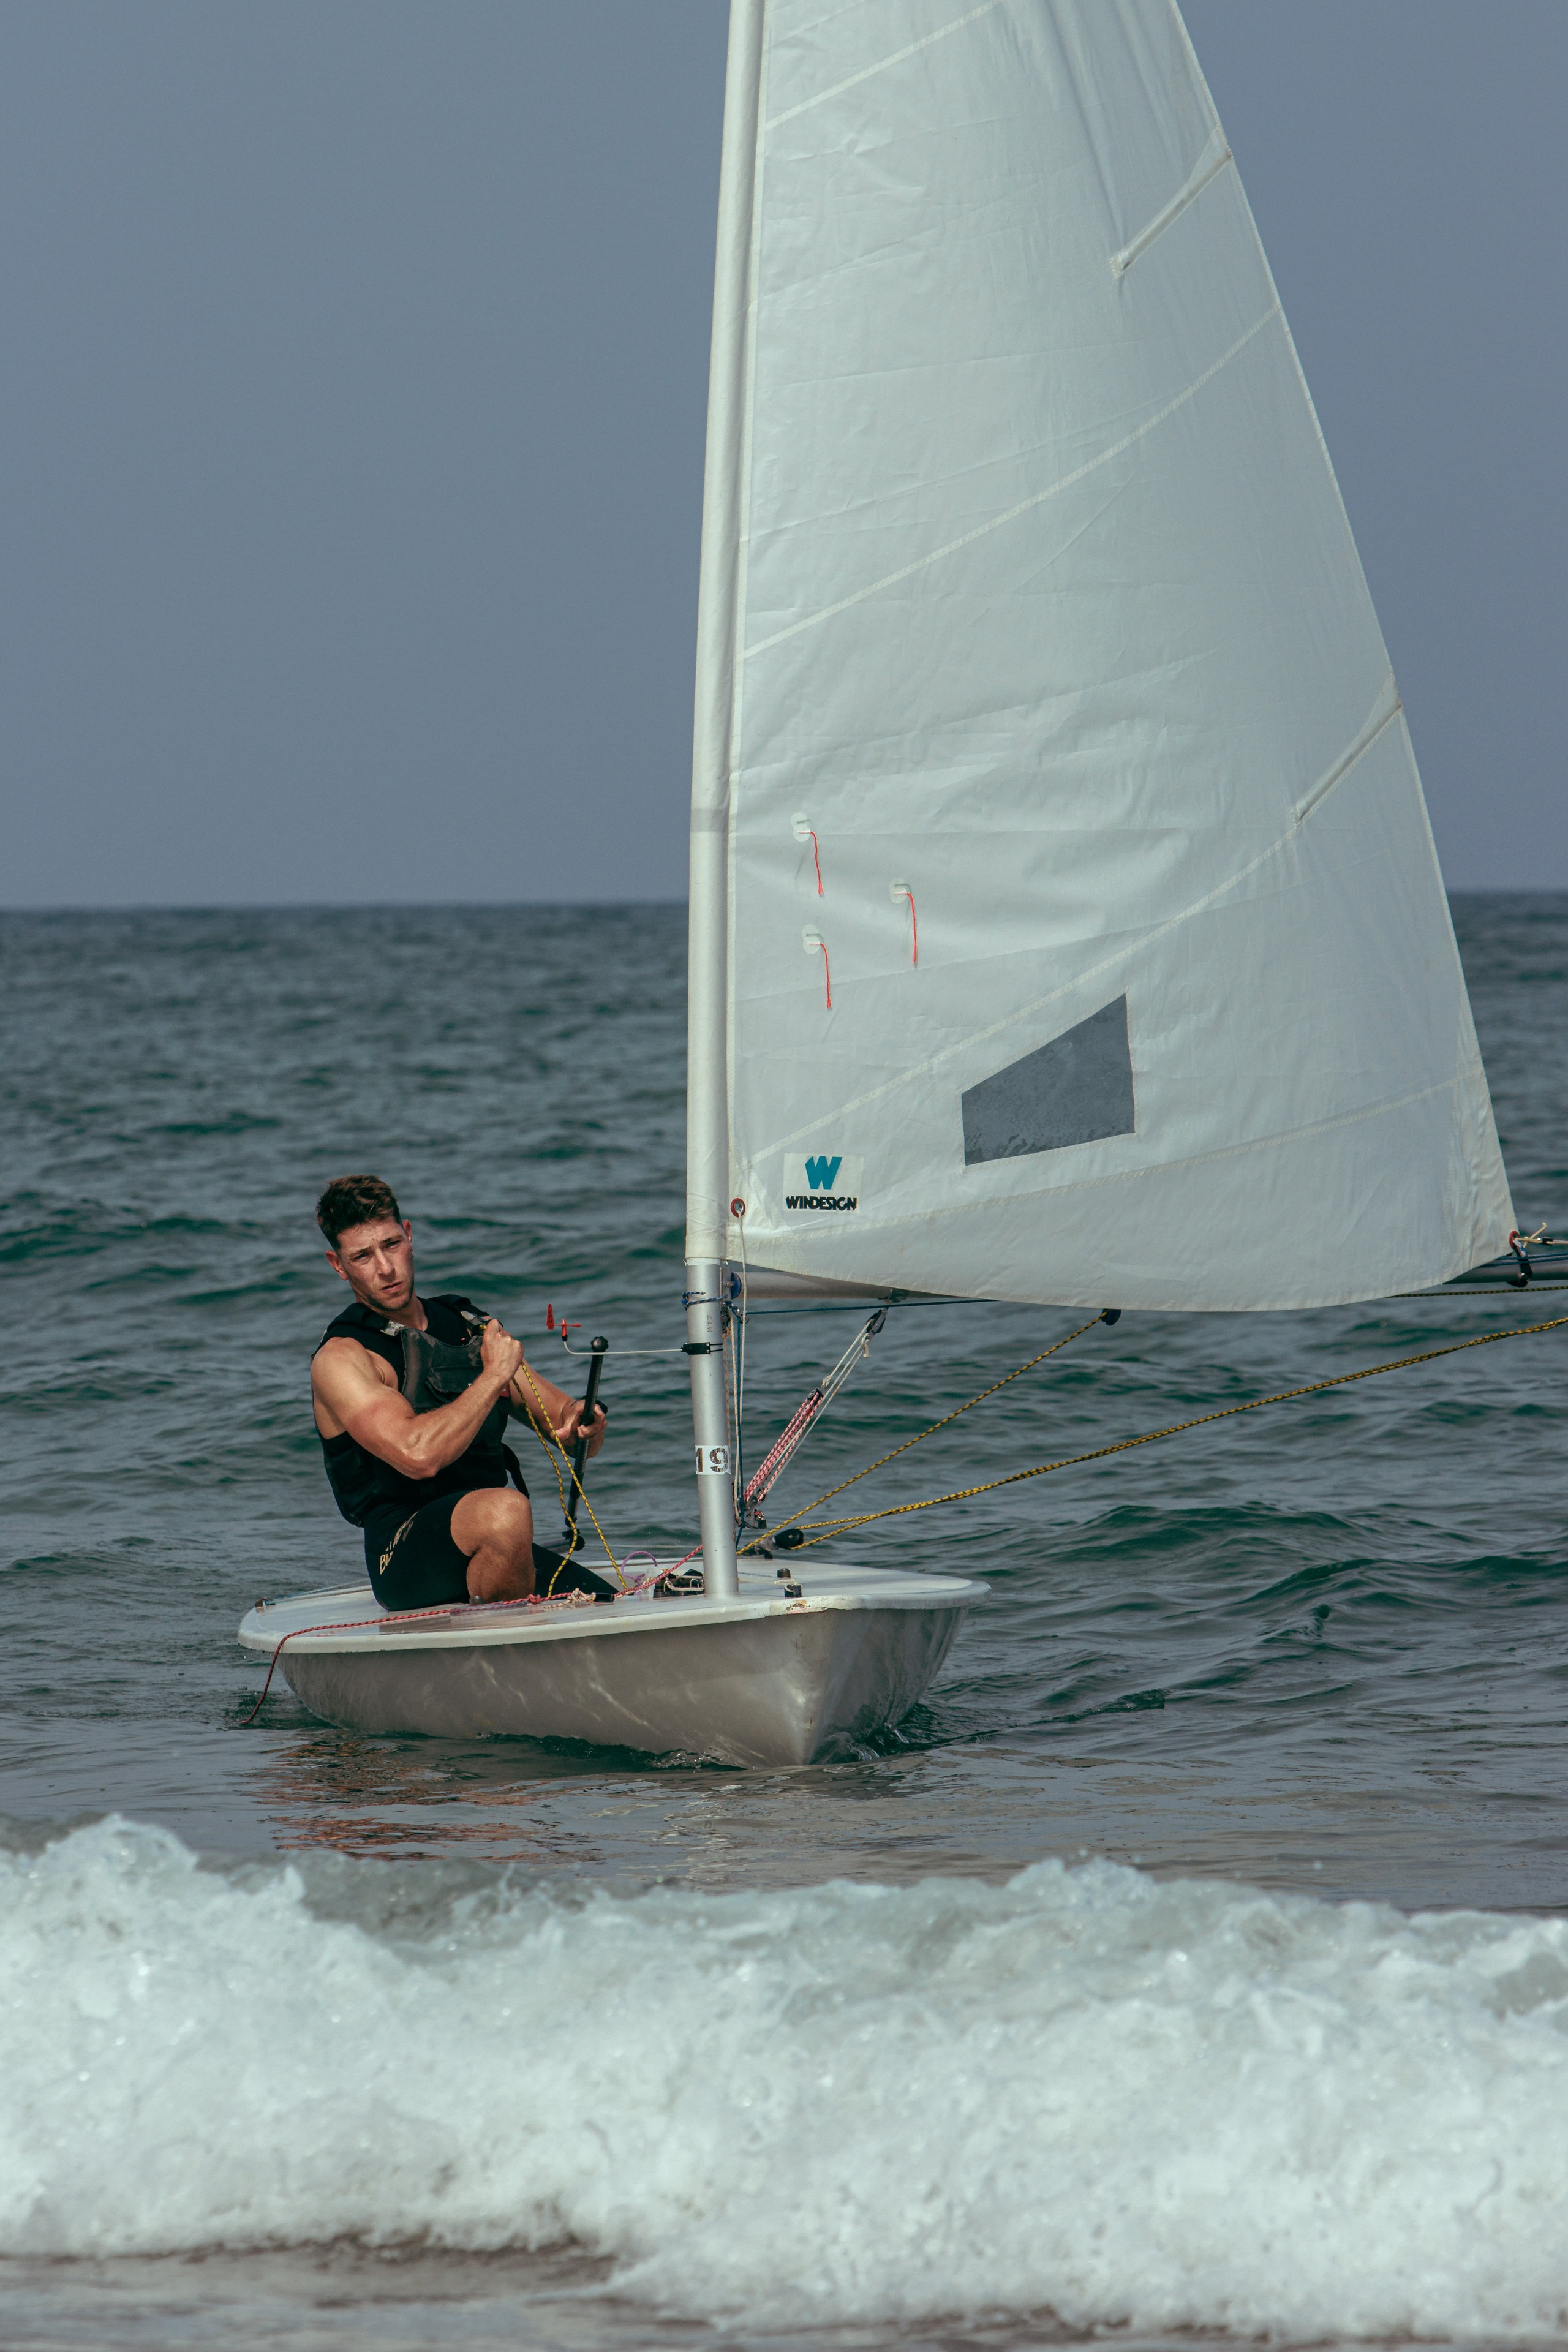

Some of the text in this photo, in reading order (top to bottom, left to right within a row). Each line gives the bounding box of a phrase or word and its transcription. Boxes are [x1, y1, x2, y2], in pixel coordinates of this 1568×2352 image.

[805, 1156, 843, 1190] W
[785, 1196, 858, 1211] WINDESIGN
[696, 1447, 728, 1473] 19
